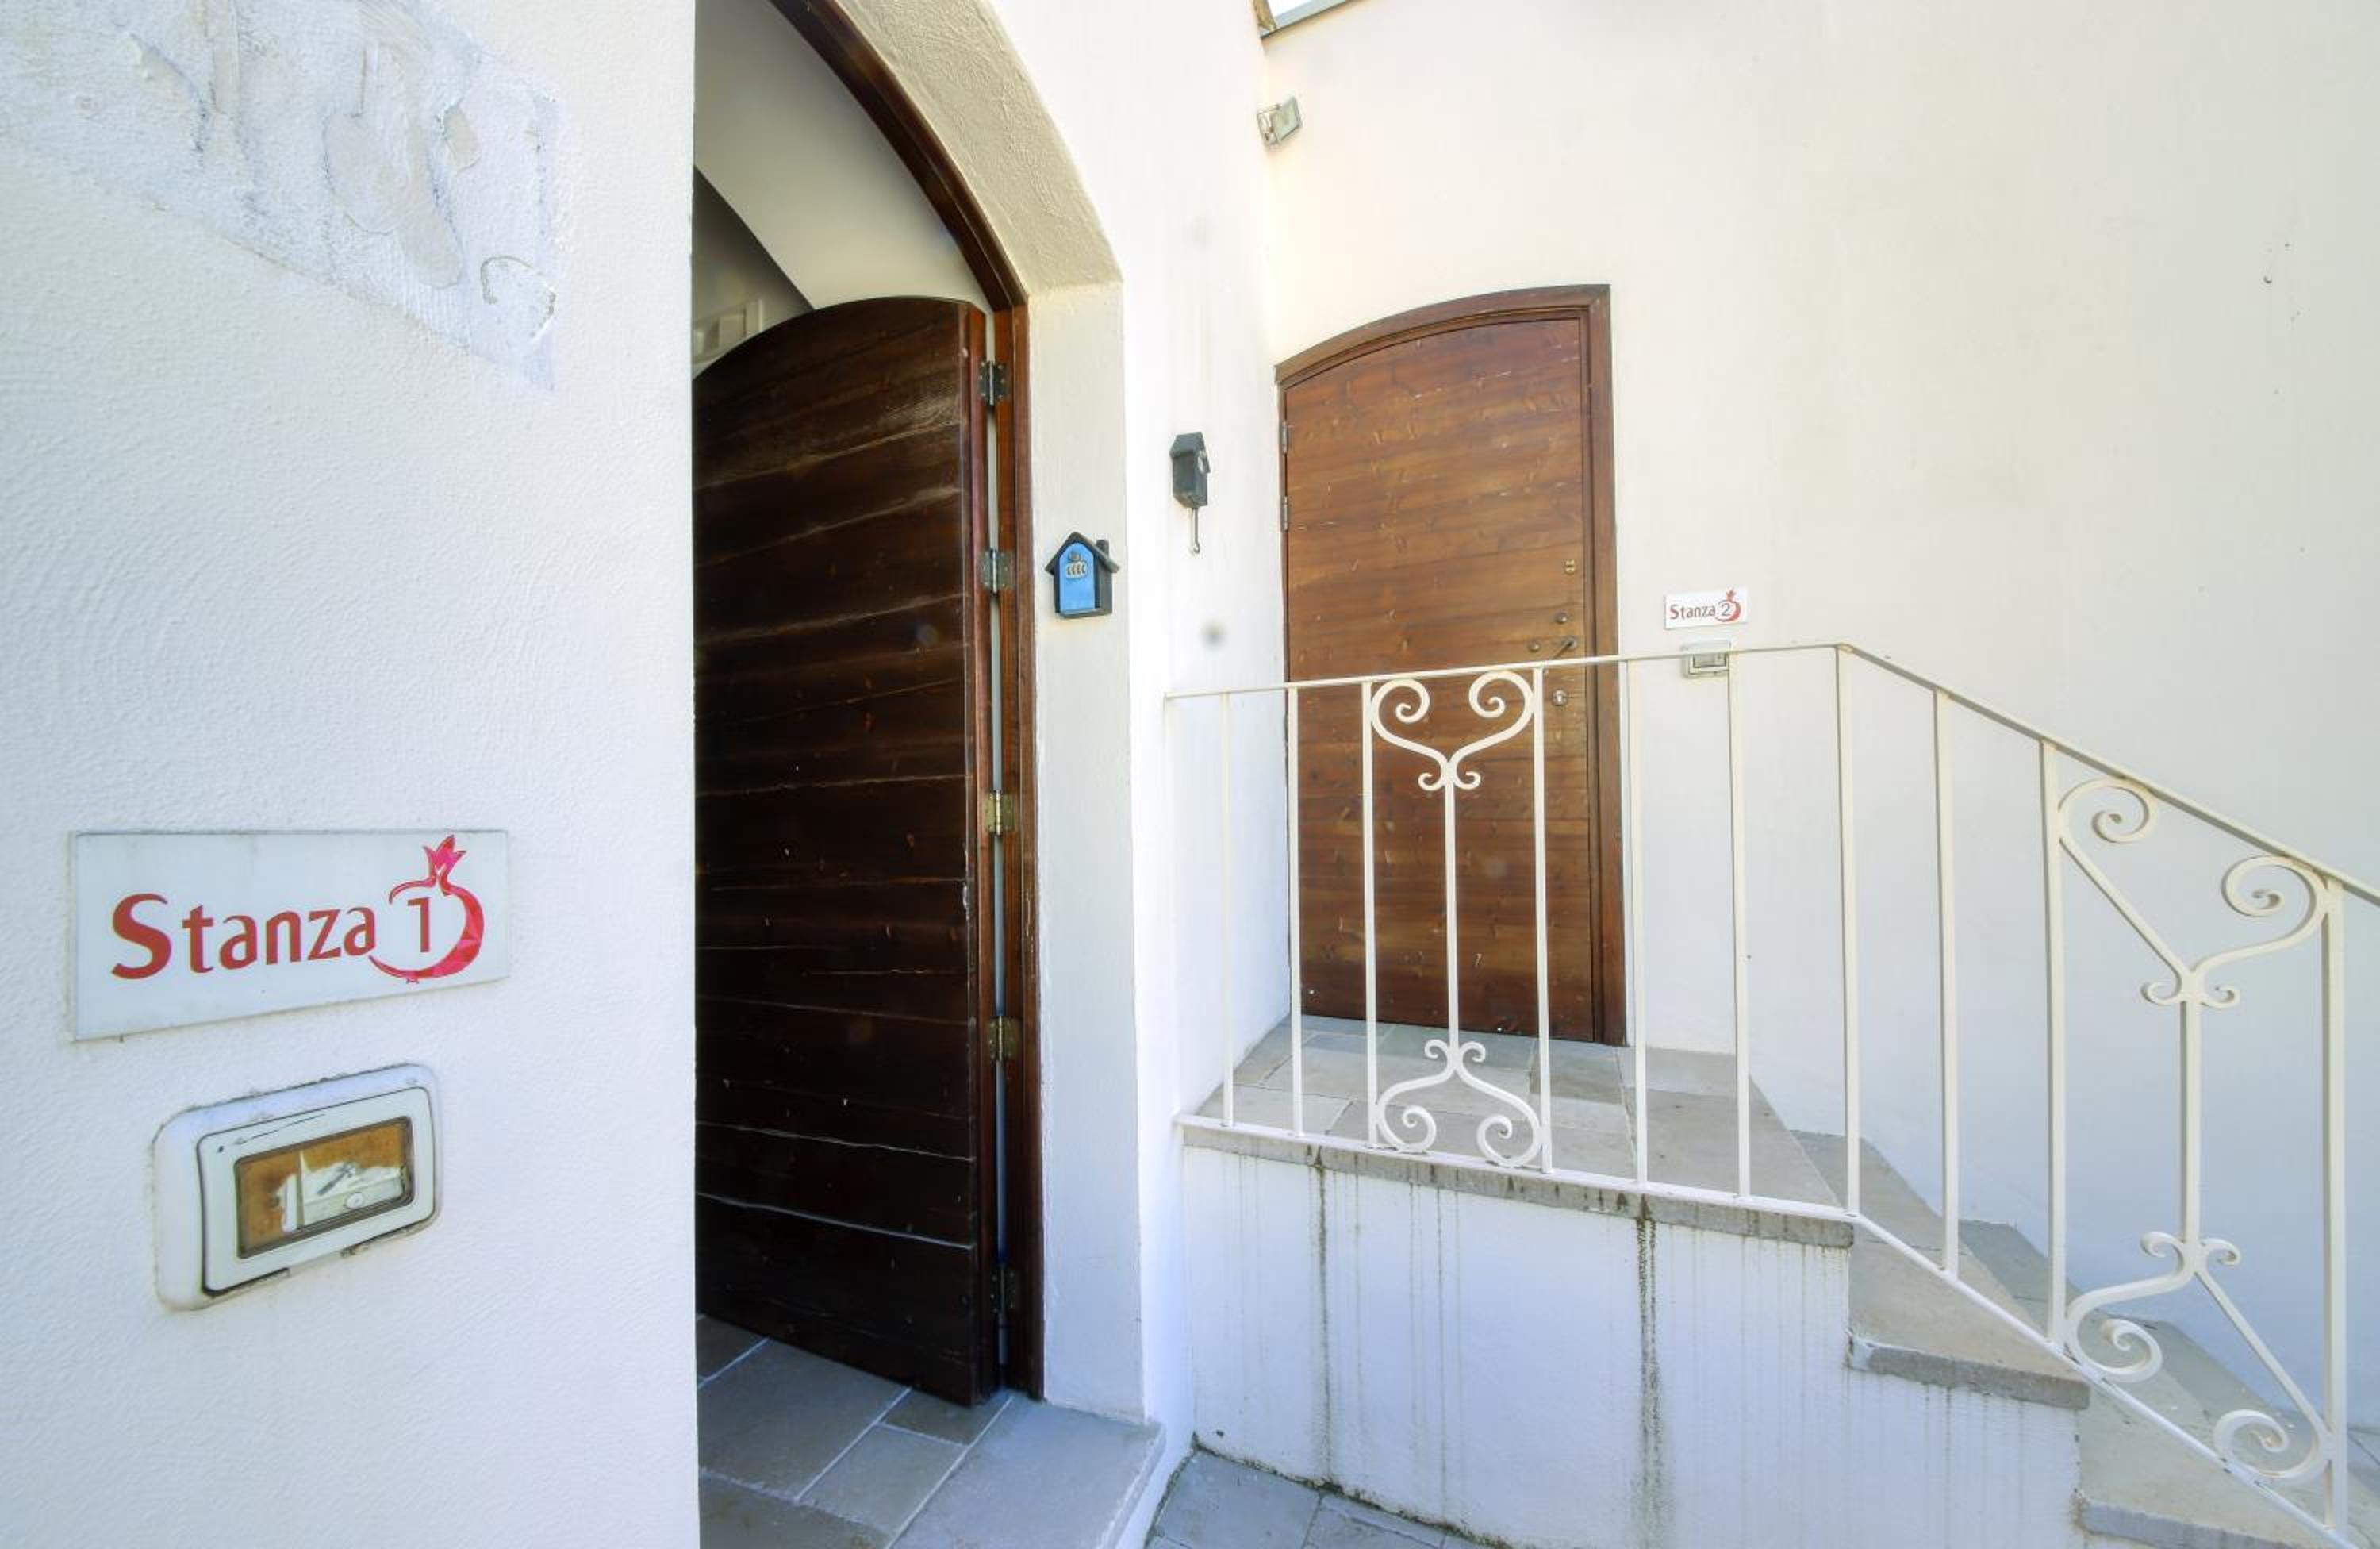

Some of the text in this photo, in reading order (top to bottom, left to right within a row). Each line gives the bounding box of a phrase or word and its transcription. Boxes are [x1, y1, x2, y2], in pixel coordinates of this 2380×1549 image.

[1669, 602, 1730, 620] Stanza 2
[111, 893, 432, 979] Stanza 1
